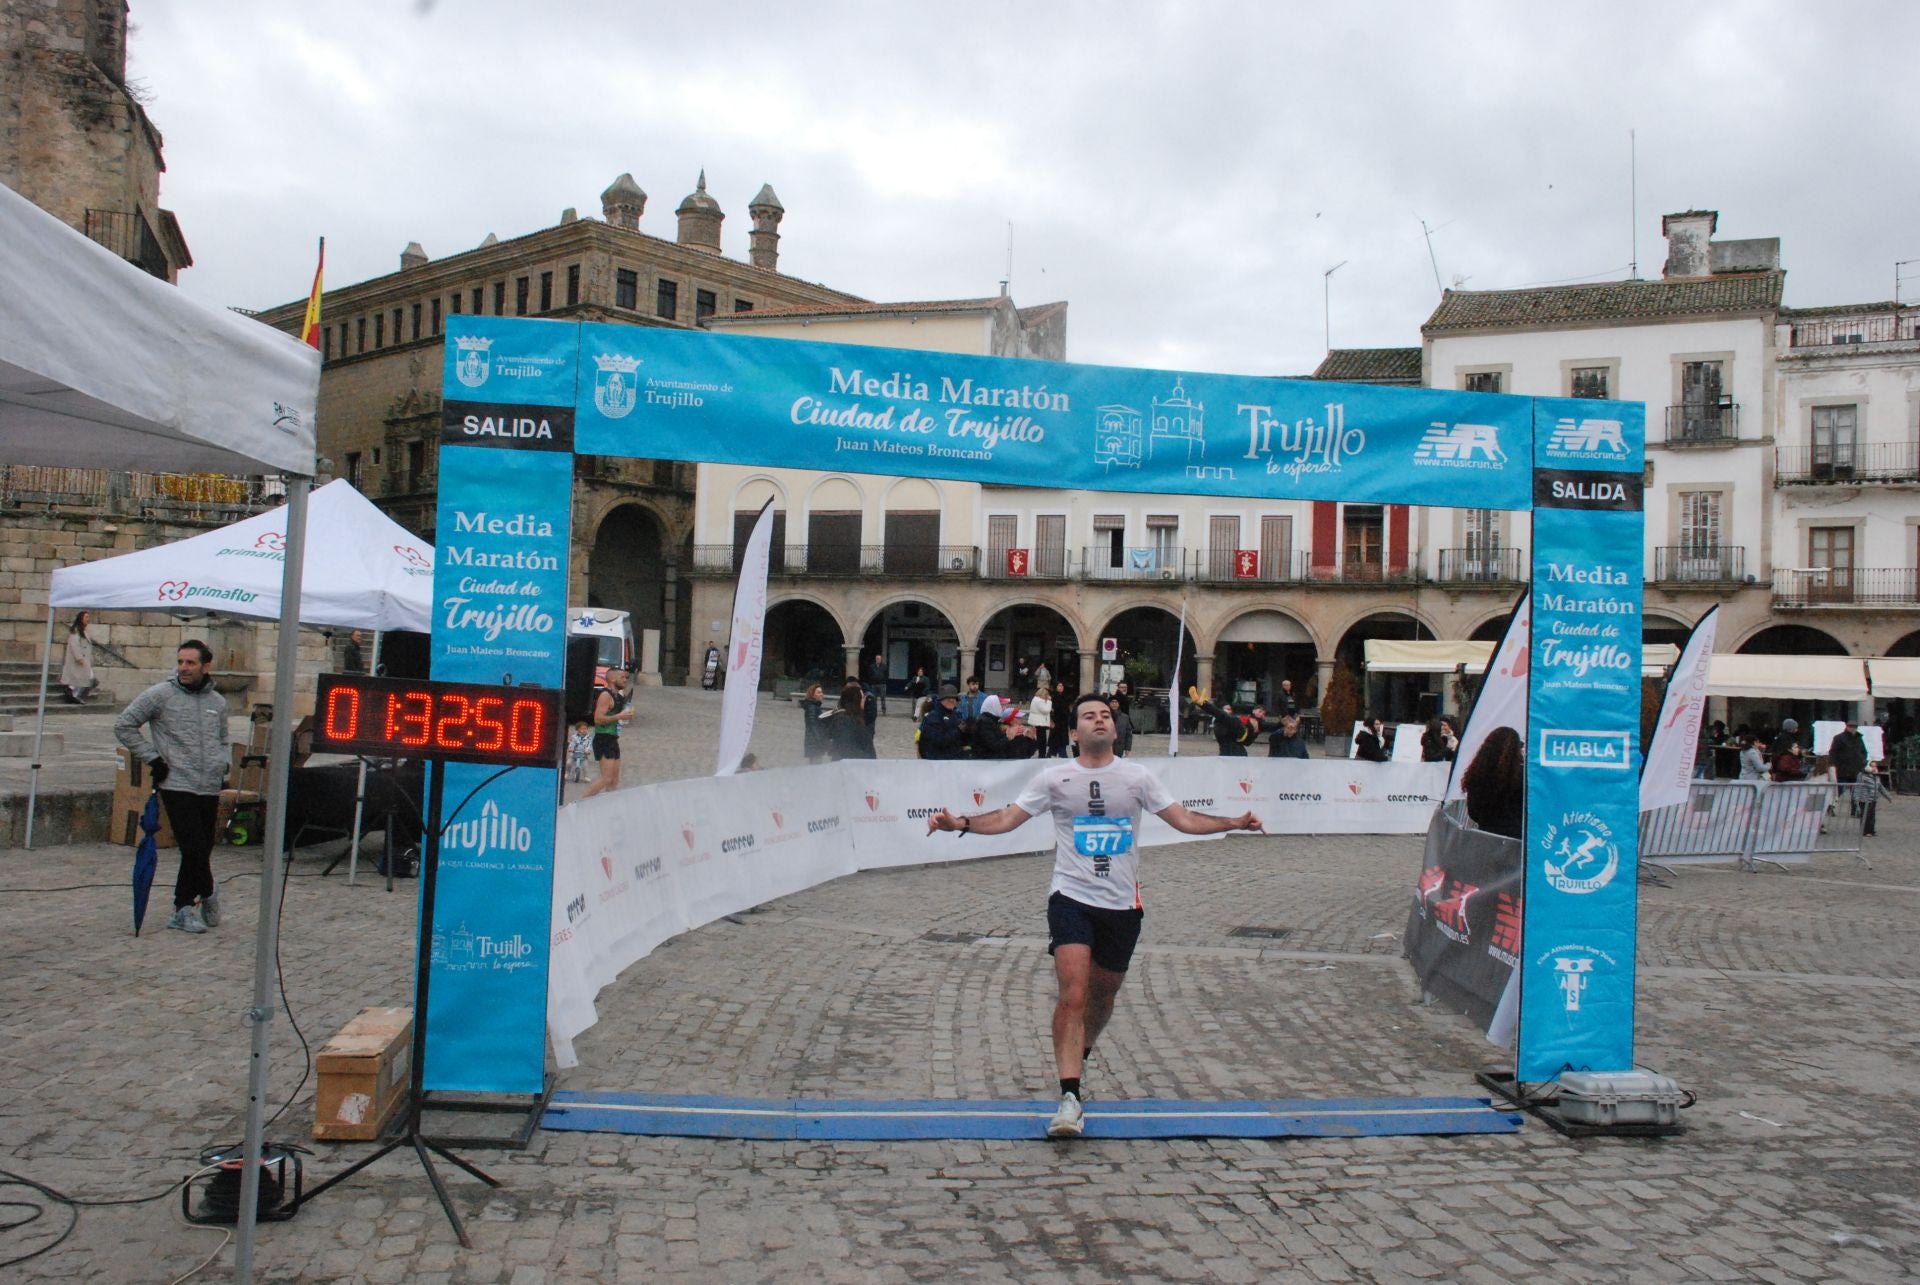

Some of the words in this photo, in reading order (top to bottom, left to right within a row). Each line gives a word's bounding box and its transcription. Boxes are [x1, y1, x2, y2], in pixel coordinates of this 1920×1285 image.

[496, 364, 542, 379] Trujillo
[646, 377, 719, 393] Ayuntamiento
[720, 382, 733, 393] de
[828, 367, 930, 402] Media
[939, 375, 1071, 412] Maratón
[644, 390, 704, 410] Trujillo
[463, 415, 553, 439] SALIDA
[790, 396, 895, 431] Ciudad
[900, 408, 938, 434] de
[945, 408, 1045, 450] Trujillo
[1237, 402, 1366, 467] Trujillo
[834, 437, 868, 452] Juan
[873, 440, 923, 456] Mateos
[928, 443, 993, 461] Broncano
[1546, 449, 1626, 461] www.musicrun.es
[1266, 455, 1281, 475] te
[1413, 457, 1504, 471] www.musicrun.es
[1552, 480, 1627, 501] SALIDA
[453, 511, 553, 537] Media
[216, 546, 286, 562] primaflo
[445, 545, 559, 571] Maratón
[1547, 563, 1629, 585] Media
[184, 585, 259, 603] primaflor
[459, 576, 516, 595] Ciudad
[519, 581, 542, 596] de
[1543, 593, 1635, 614] Maratón
[443, 597, 553, 642] Trujillo
[1552, 620, 1600, 637] Ciudad
[1602, 624, 1620, 637] de
[446, 644, 468, 655] Juan
[471, 645, 503, 656] Mateos
[506, 647, 550, 658] Broncano
[1540, 638, 1631, 677] Trujillo
[1689, 693, 1702, 712] DE
[1552, 740, 1616, 759] HABLA
[1541, 823, 1558, 849] Club
[1562, 810, 1613, 837] Atletismo
[1085, 833, 1122, 852] 577
[476, 935, 533, 959] Trujillo
